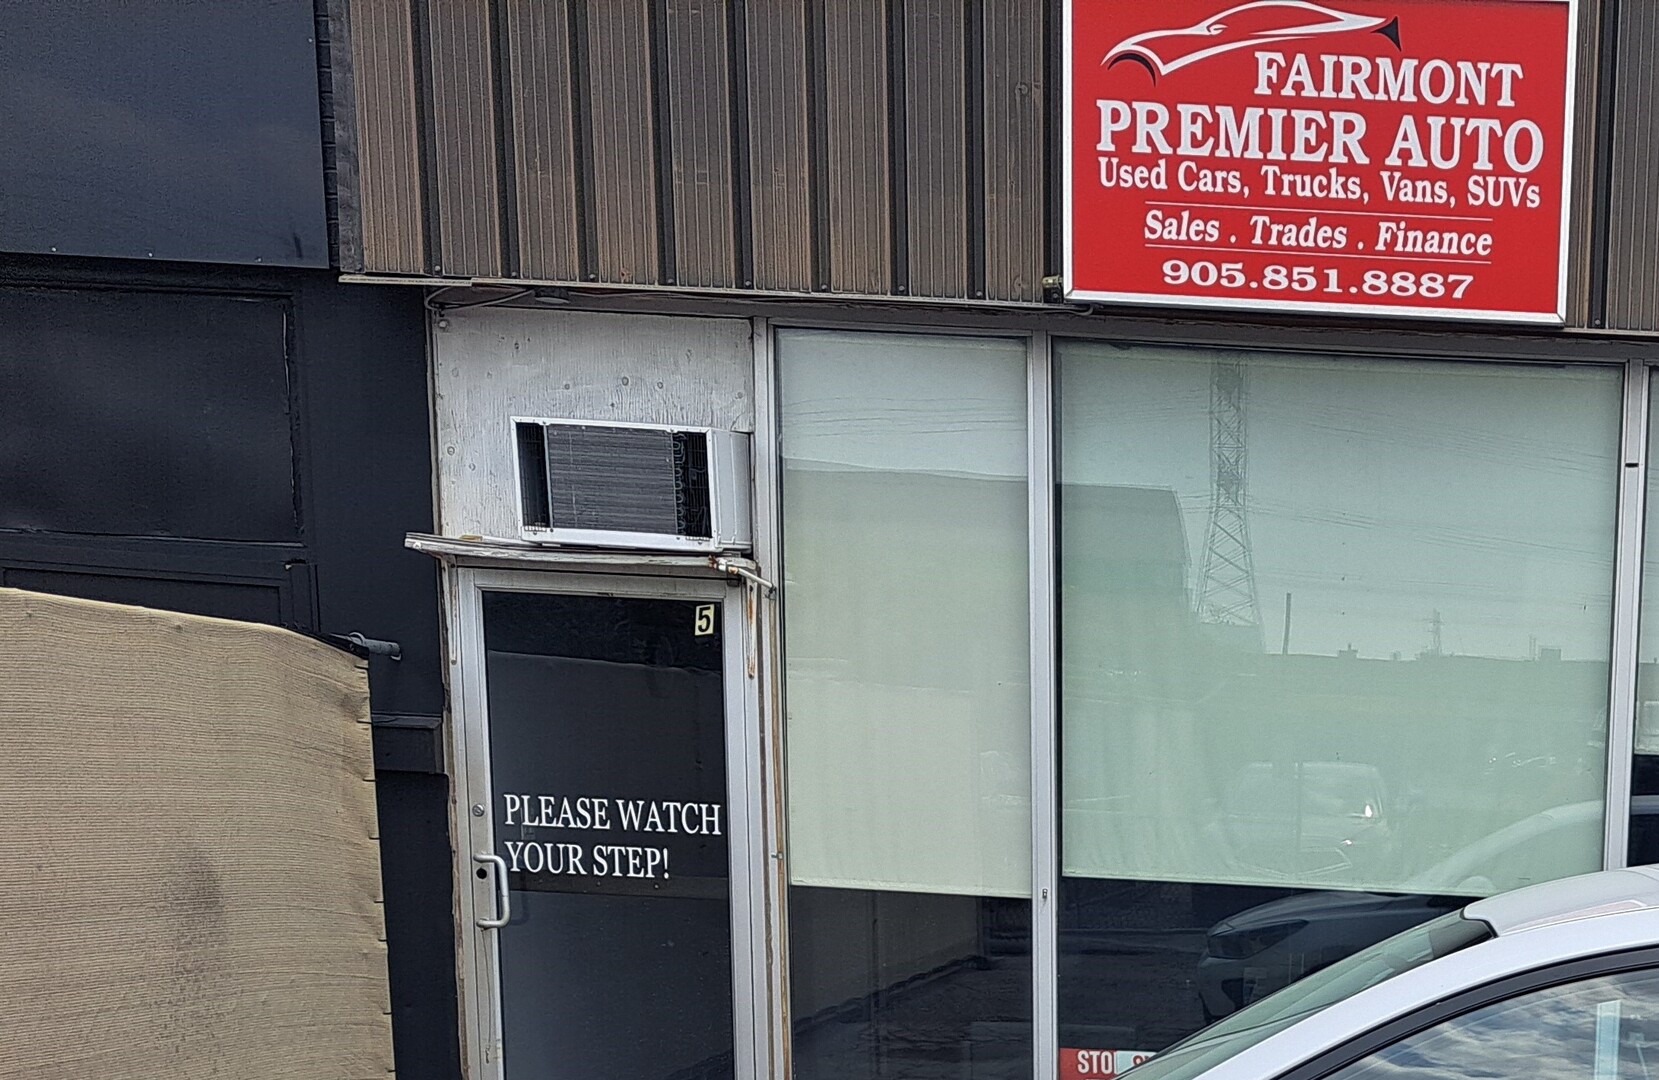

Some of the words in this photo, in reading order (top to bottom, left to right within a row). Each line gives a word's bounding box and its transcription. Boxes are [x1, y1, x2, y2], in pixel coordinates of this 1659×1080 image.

[1254, 51, 1523, 107] FAIRMONT
[1096, 99, 1369, 165] PREMIER
[1385, 115, 1544, 173] AUTO
[1098, 157, 1168, 190] Used
[1178, 160, 1250, 199] Cars,
[1261, 165, 1369, 205] Trucks,
[1380, 171, 1456, 209] Vans,
[1467, 175, 1540, 208] SUVs
[1144, 210, 1220, 243] Sales
[1250, 216, 1347, 249] Trades
[1375, 221, 1493, 256] Finance
[1162, 260, 1474, 299] 905.851.8887
[697, 605, 712, 633] 5
[504, 794, 611, 830] PLEASE
[615, 799, 722, 835] WATCH
[504, 841, 587, 876] YOUR
[592, 845, 671, 879] STEP!
